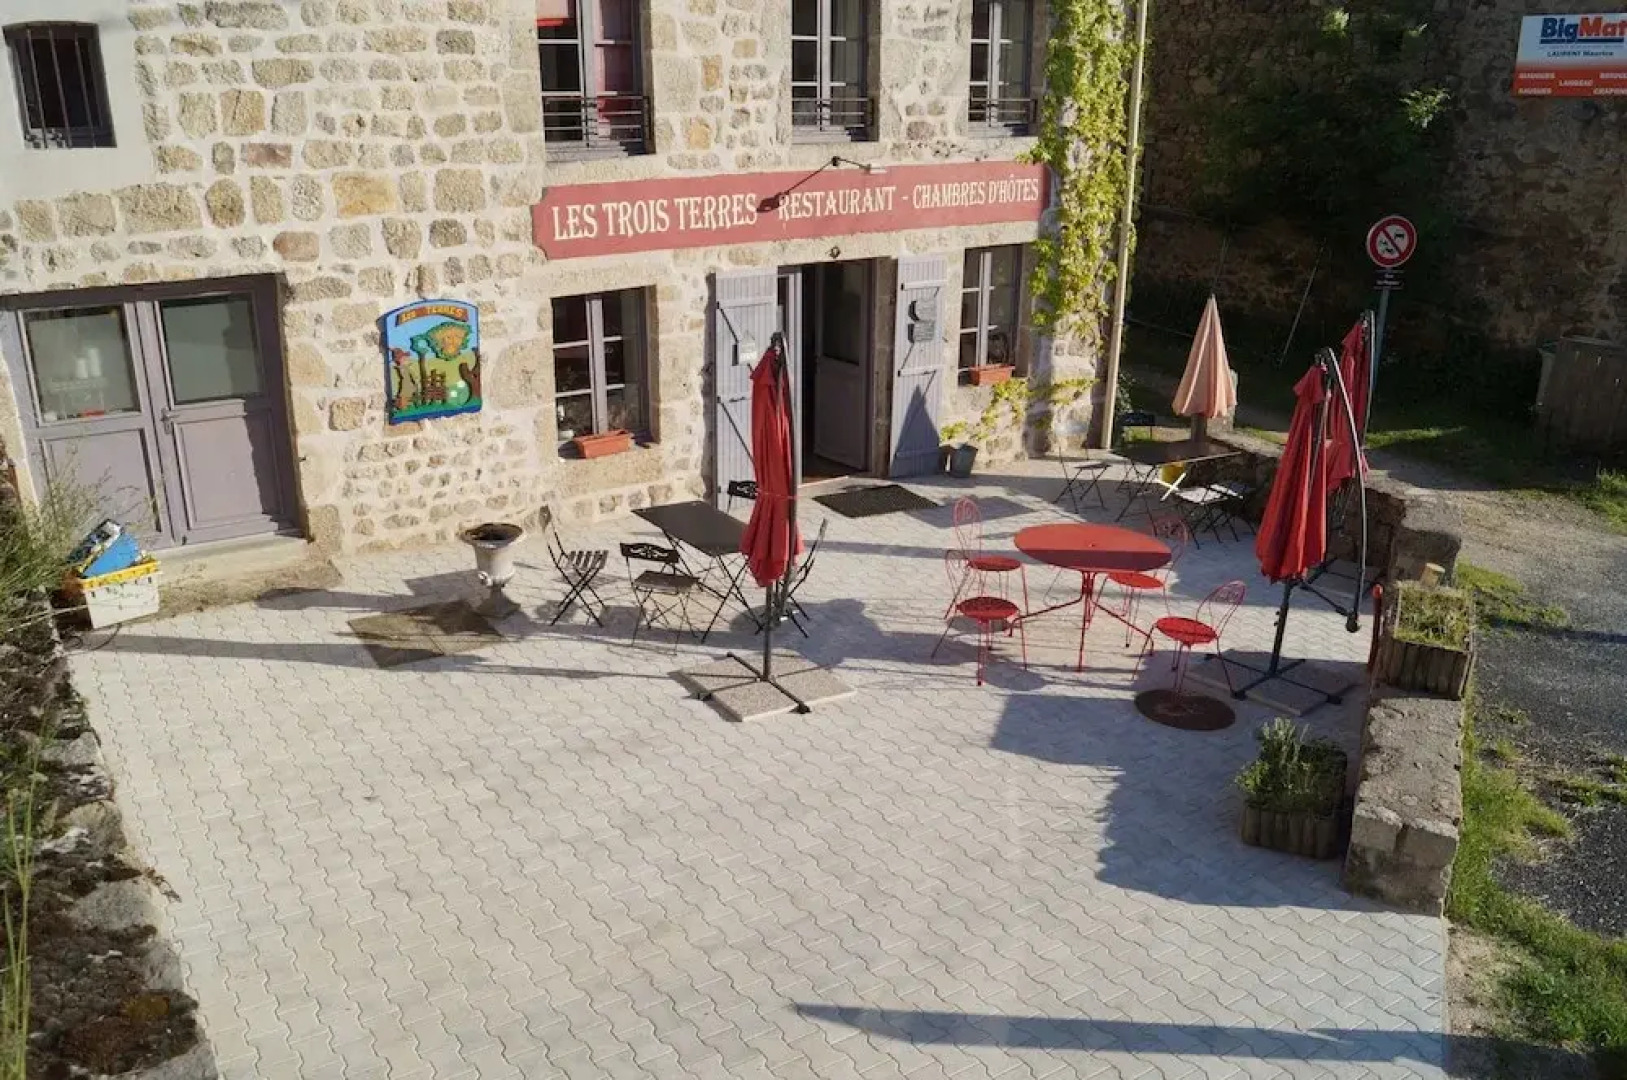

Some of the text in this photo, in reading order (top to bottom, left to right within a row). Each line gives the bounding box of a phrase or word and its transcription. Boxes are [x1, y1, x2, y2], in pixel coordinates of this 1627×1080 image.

[552, 204, 598, 241] LES
[602, 199, 670, 238] TROIS
[674, 193, 758, 232] TERRES
[778, 185, 897, 222] RESTAURANT
[912, 180, 986, 210] CHAMBRES
[988, 173, 1039, 204] D'HÔTES
